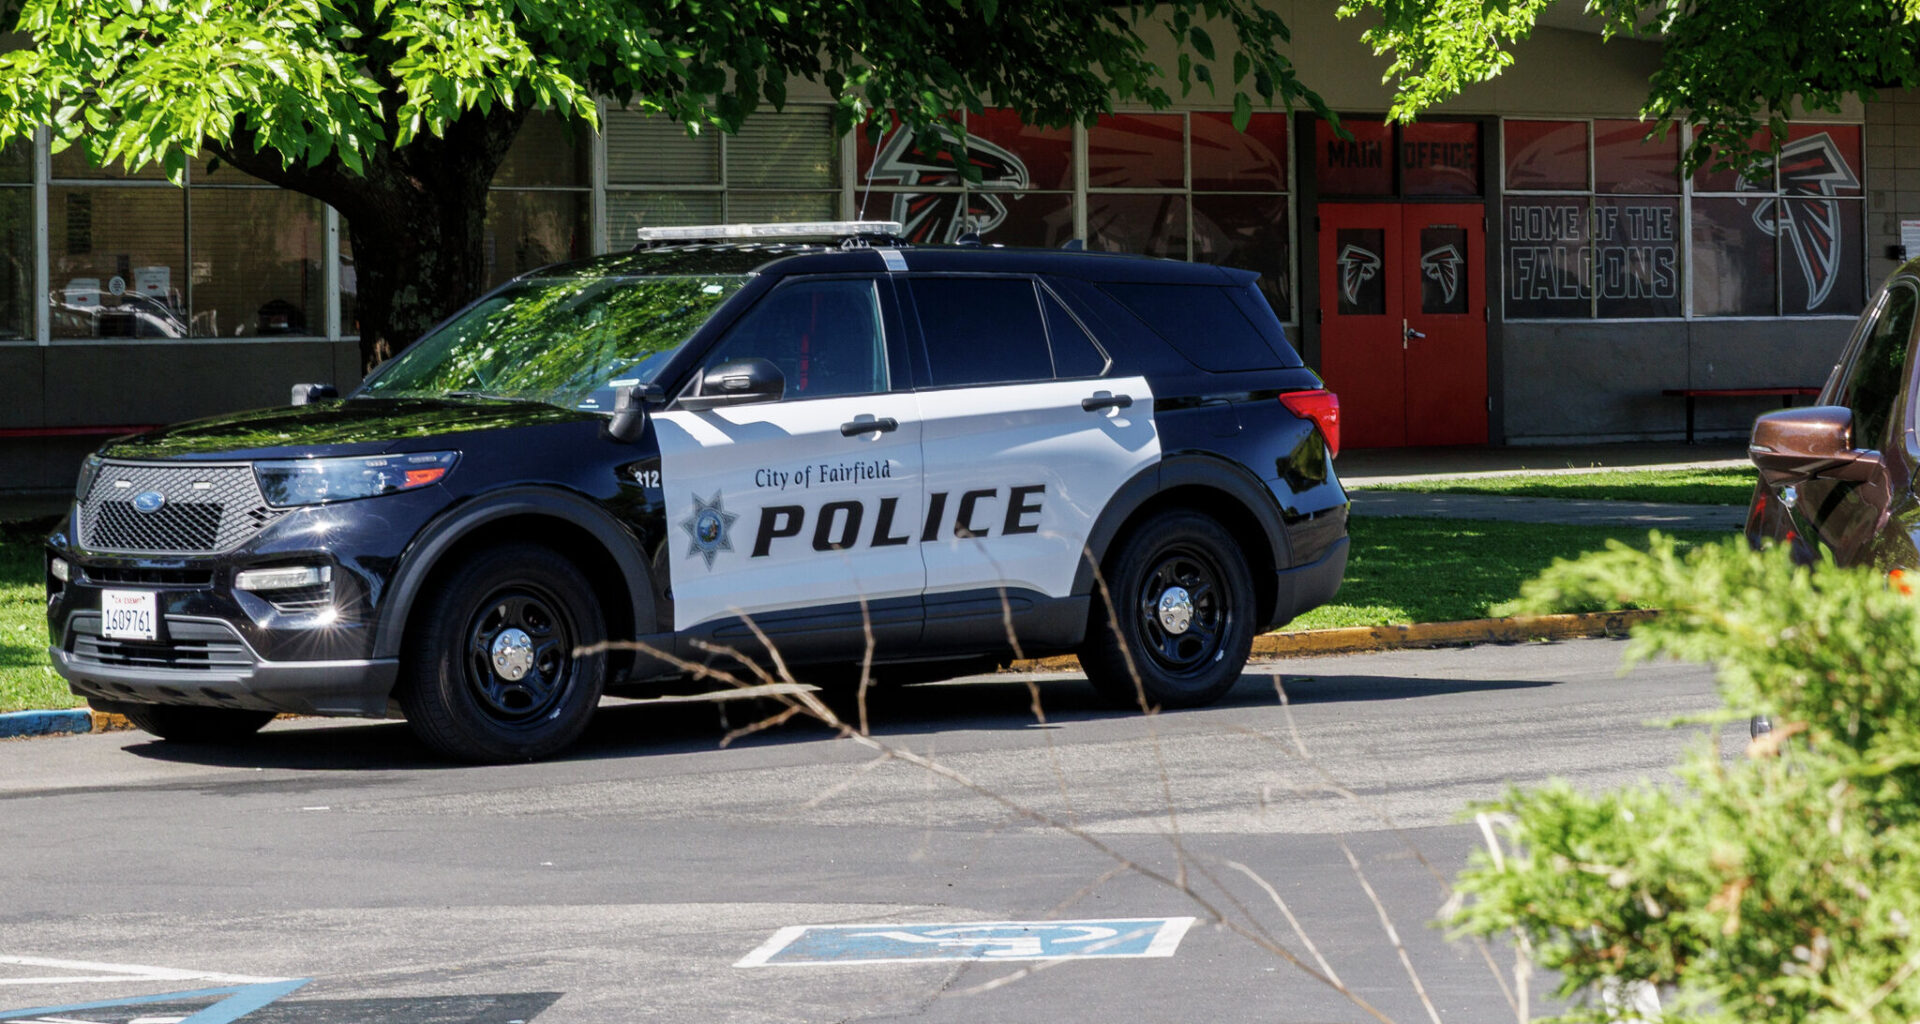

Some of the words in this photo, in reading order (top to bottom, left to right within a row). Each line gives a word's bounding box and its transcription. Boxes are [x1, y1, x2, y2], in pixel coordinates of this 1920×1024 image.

[1327, 140, 1383, 169] MAIN
[1403, 141, 1476, 169] OFFICE
[1509, 206, 1580, 241] HOME
[1586, 206, 1619, 241] OF
[1625, 206, 1674, 241] THE
[1510, 246, 1677, 300] FALCONS
[754, 468, 789, 491] City
[794, 465, 812, 488] of
[819, 459, 892, 485] Fairfield
[751, 484, 1046, 558] POLICE
[105, 609, 151, 632] 1609761
